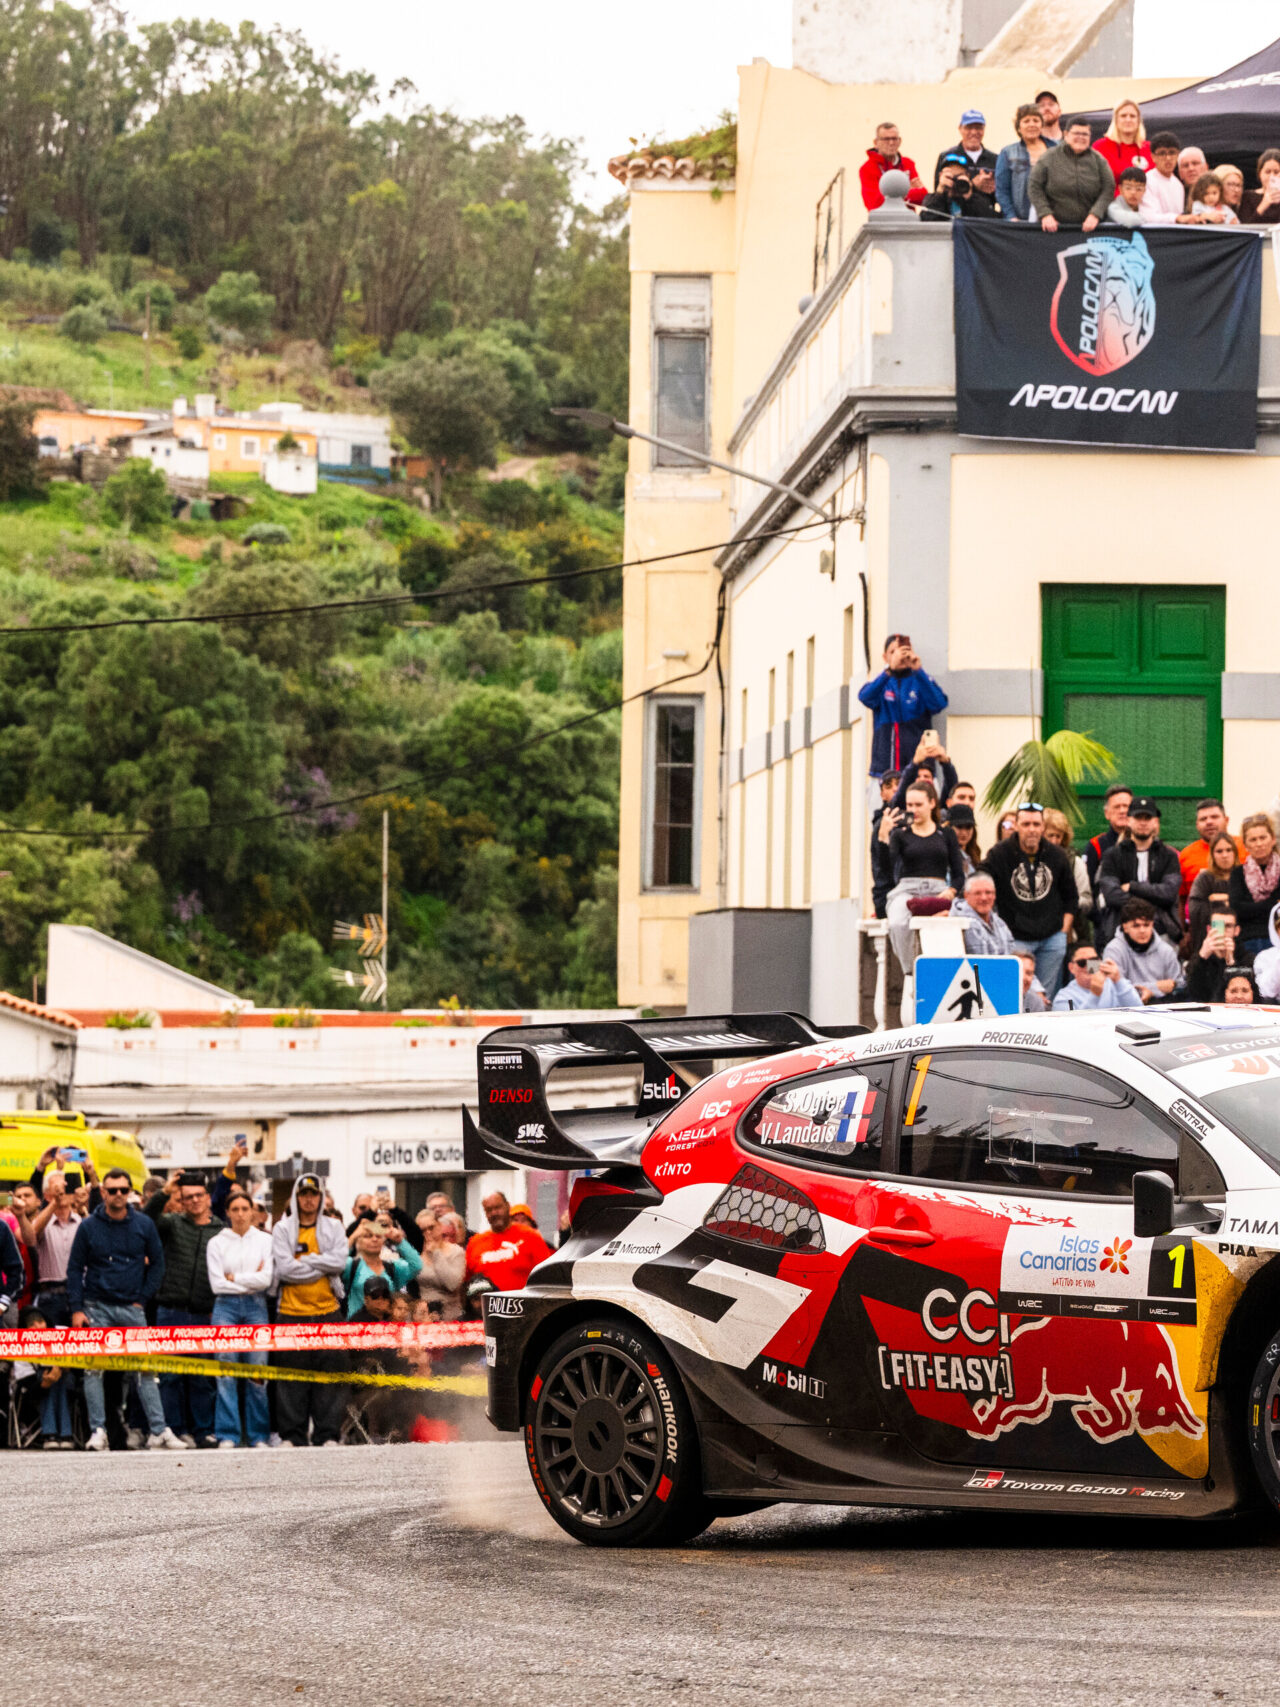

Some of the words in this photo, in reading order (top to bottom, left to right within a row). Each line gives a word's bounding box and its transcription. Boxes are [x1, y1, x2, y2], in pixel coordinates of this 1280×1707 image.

[1009, 383, 1179, 415] APOLOCAN
[981, 1031, 1049, 1047] PROTERIAL
[745, 1069, 771, 1078] JAPAN
[643, 1074, 681, 1099] Stilo
[905, 1055, 932, 1126] 1
[489, 1089, 533, 1104] DENSO
[782, 1090, 846, 1117] S.Ogier
[1171, 1101, 1208, 1138] CENTRAL
[517, 1123, 548, 1139] SWS
[760, 1120, 836, 1145] V.Landais
[372, 1141, 412, 1165] delta
[433, 1146, 463, 1162] auto
[620, 1241, 661, 1256] Microsoft
[1060, 1235, 1099, 1254] Islas
[1218, 1243, 1257, 1258] PIAA
[1020, 1250, 1097, 1273] Canarias
[1168, 1244, 1186, 1289] 1
[1075, 1279, 1082, 1287] DE
[1083, 1279, 1096, 1288] VIDA
[488, 1297, 525, 1315] ENDLESS
[1018, 1299, 1043, 1308] WRC
[21, 1330, 66, 1342] PROHIBIDO
[68, 1329, 104, 1340] PUBLICO
[173, 1328, 217, 1338] PROHIBIDO
[218, 1327, 253, 1338] PUBLICO
[24, 1343, 47, 1355] AREA
[51, 1343, 64, 1354] NO
[65, 1342, 102, 1354] GO-AREA
[148, 1340, 175, 1351] NO-GO
[176, 1339, 198, 1351] AREA
[202, 1339, 215, 1350] NO
[215, 1338, 252, 1350] GO-AREA
[763, 1363, 807, 1393] Mobil
[1001, 1480, 1063, 1491] TOYOTA
[1066, 1484, 1127, 1496] GAZOO
[1129, 1487, 1186, 1500] Racing
